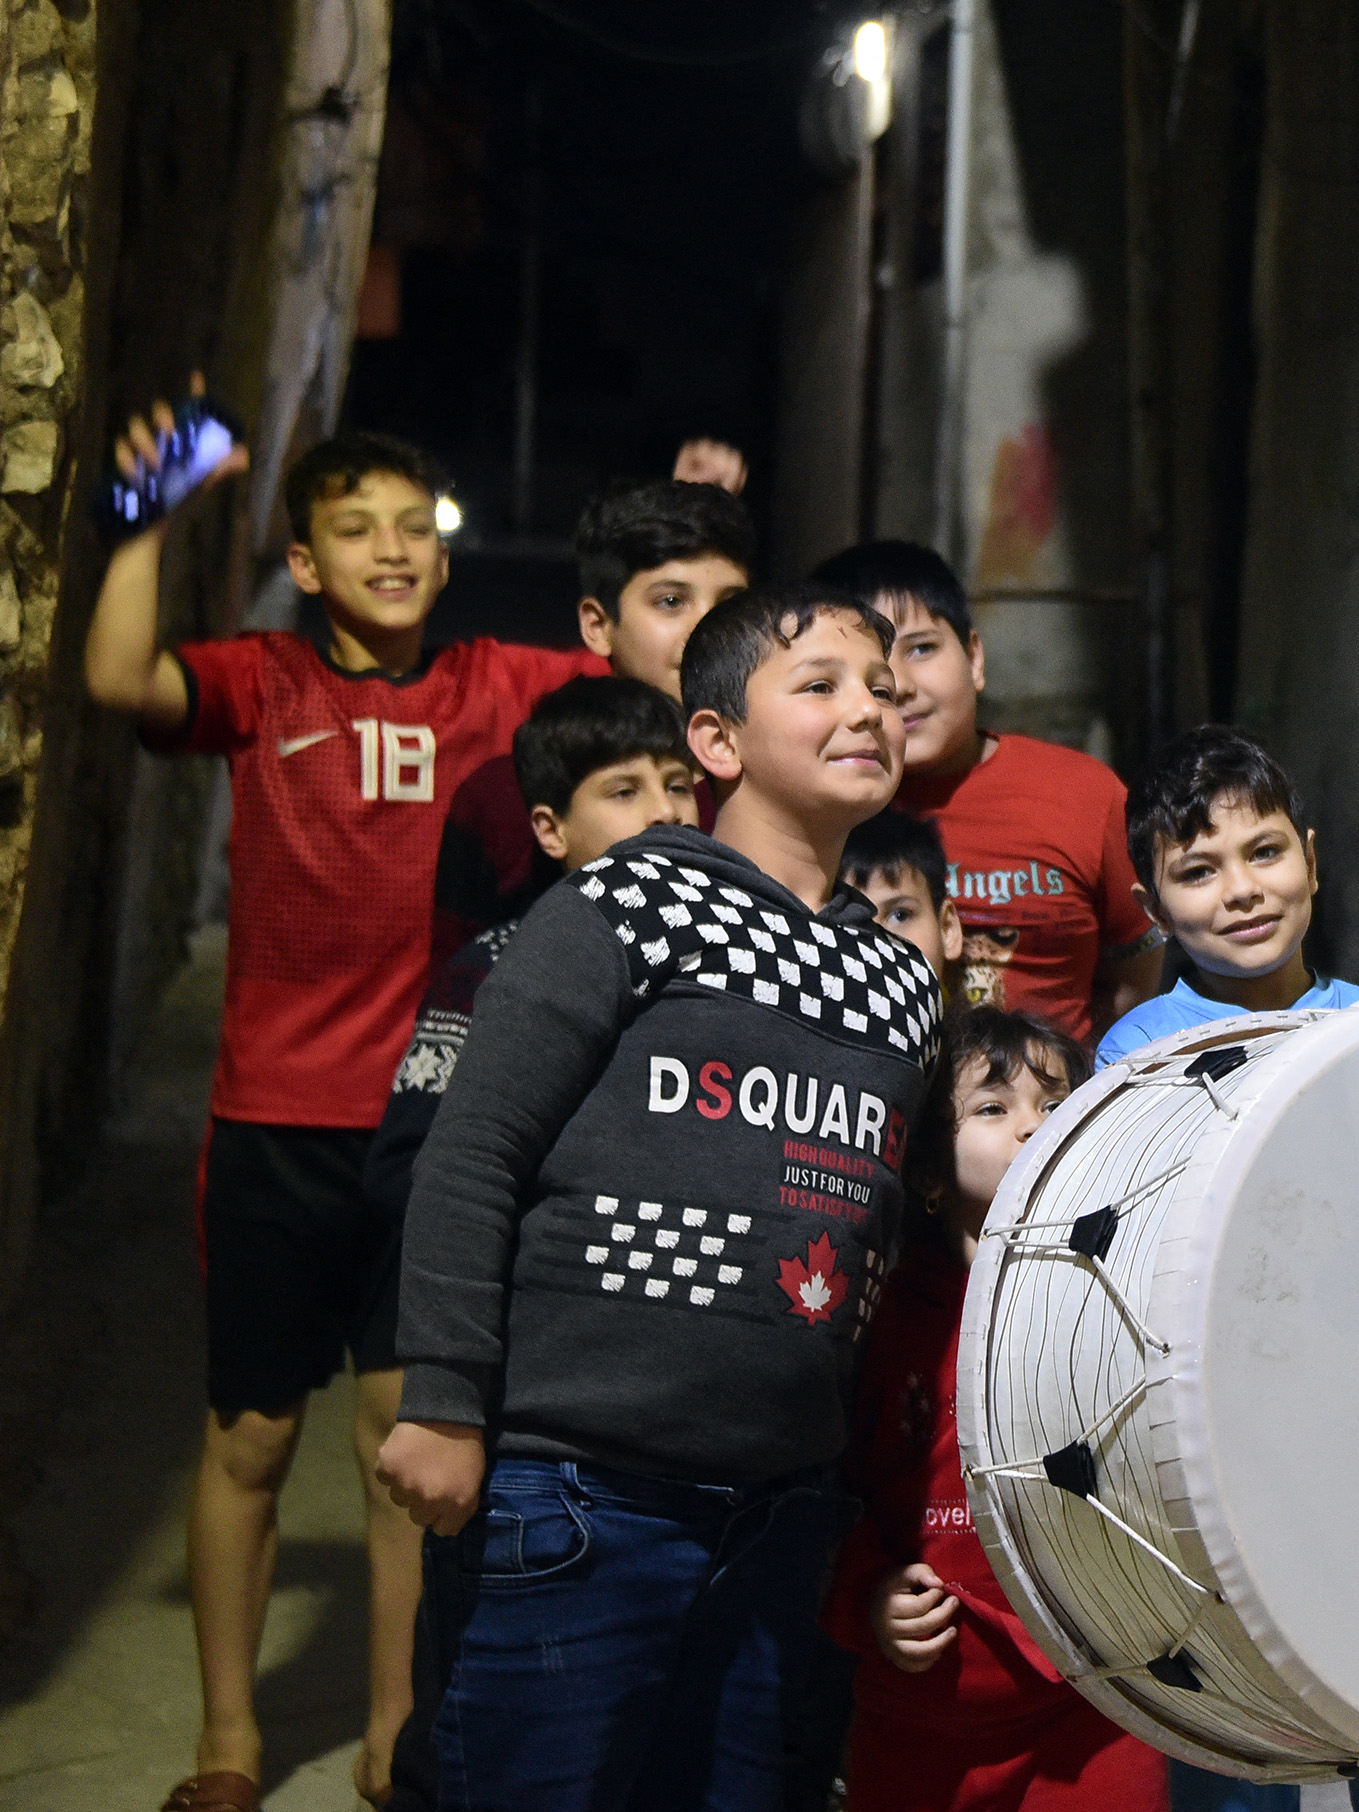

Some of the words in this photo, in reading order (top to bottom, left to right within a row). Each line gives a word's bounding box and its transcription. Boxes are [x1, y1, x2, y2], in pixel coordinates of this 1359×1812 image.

[352, 716, 436, 802] 18
[784, 1140, 817, 1164] HIGH
[819, 1148, 874, 1180] QUALITY
[779, 1186, 797, 1207] TO
[784, 1165, 819, 1188] JUST
[820, 1173, 844, 1196] FOR
[847, 1180, 870, 1204] YOU
